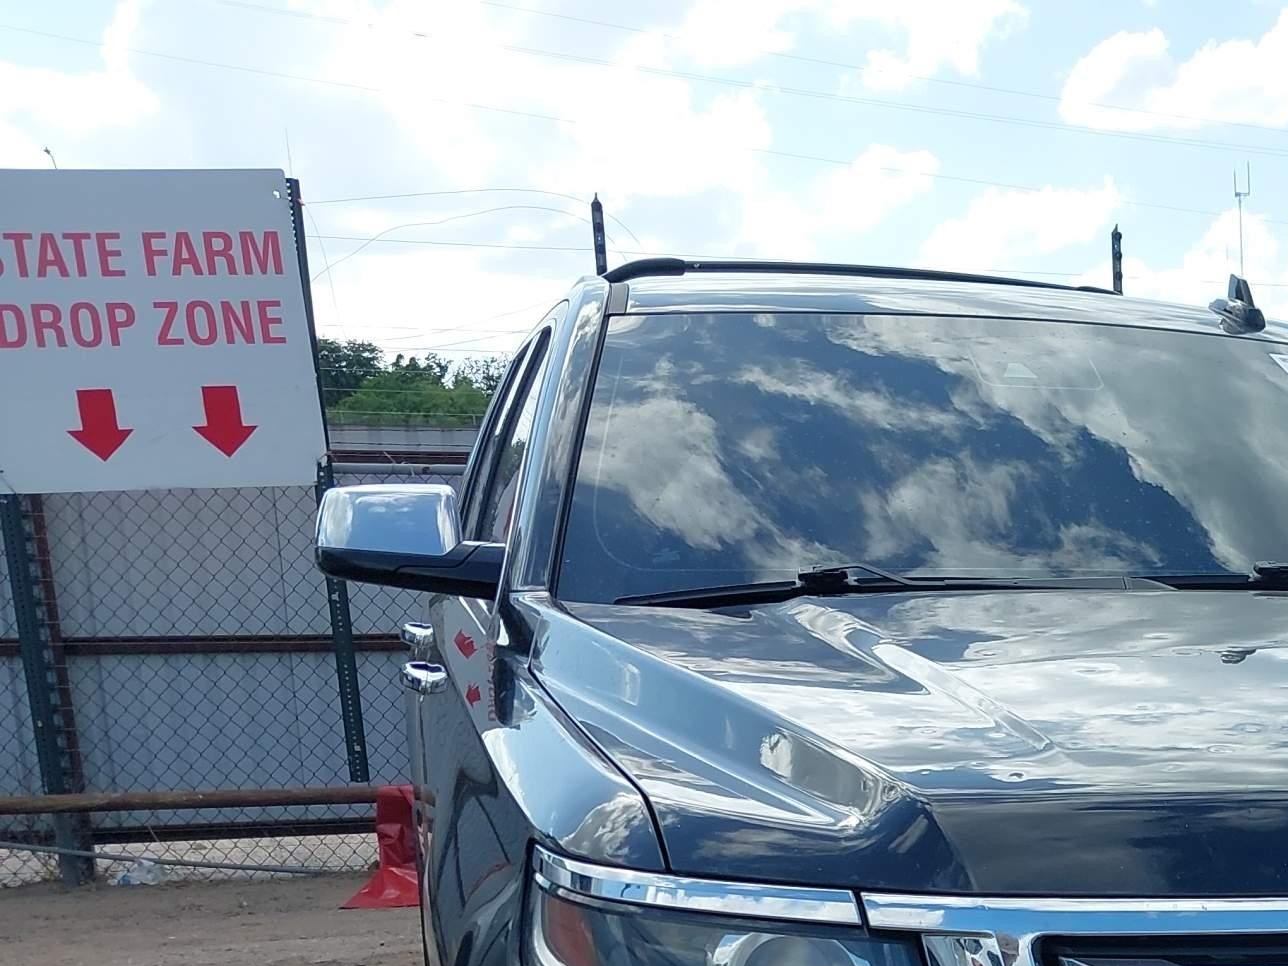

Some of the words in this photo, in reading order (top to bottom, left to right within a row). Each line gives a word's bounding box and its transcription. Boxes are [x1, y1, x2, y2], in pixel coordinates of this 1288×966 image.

[0, 231, 126, 279] TATE
[141, 230, 284, 277] FARM
[0, 301, 136, 349] DROP
[152, 299, 287, 346] ZONE
